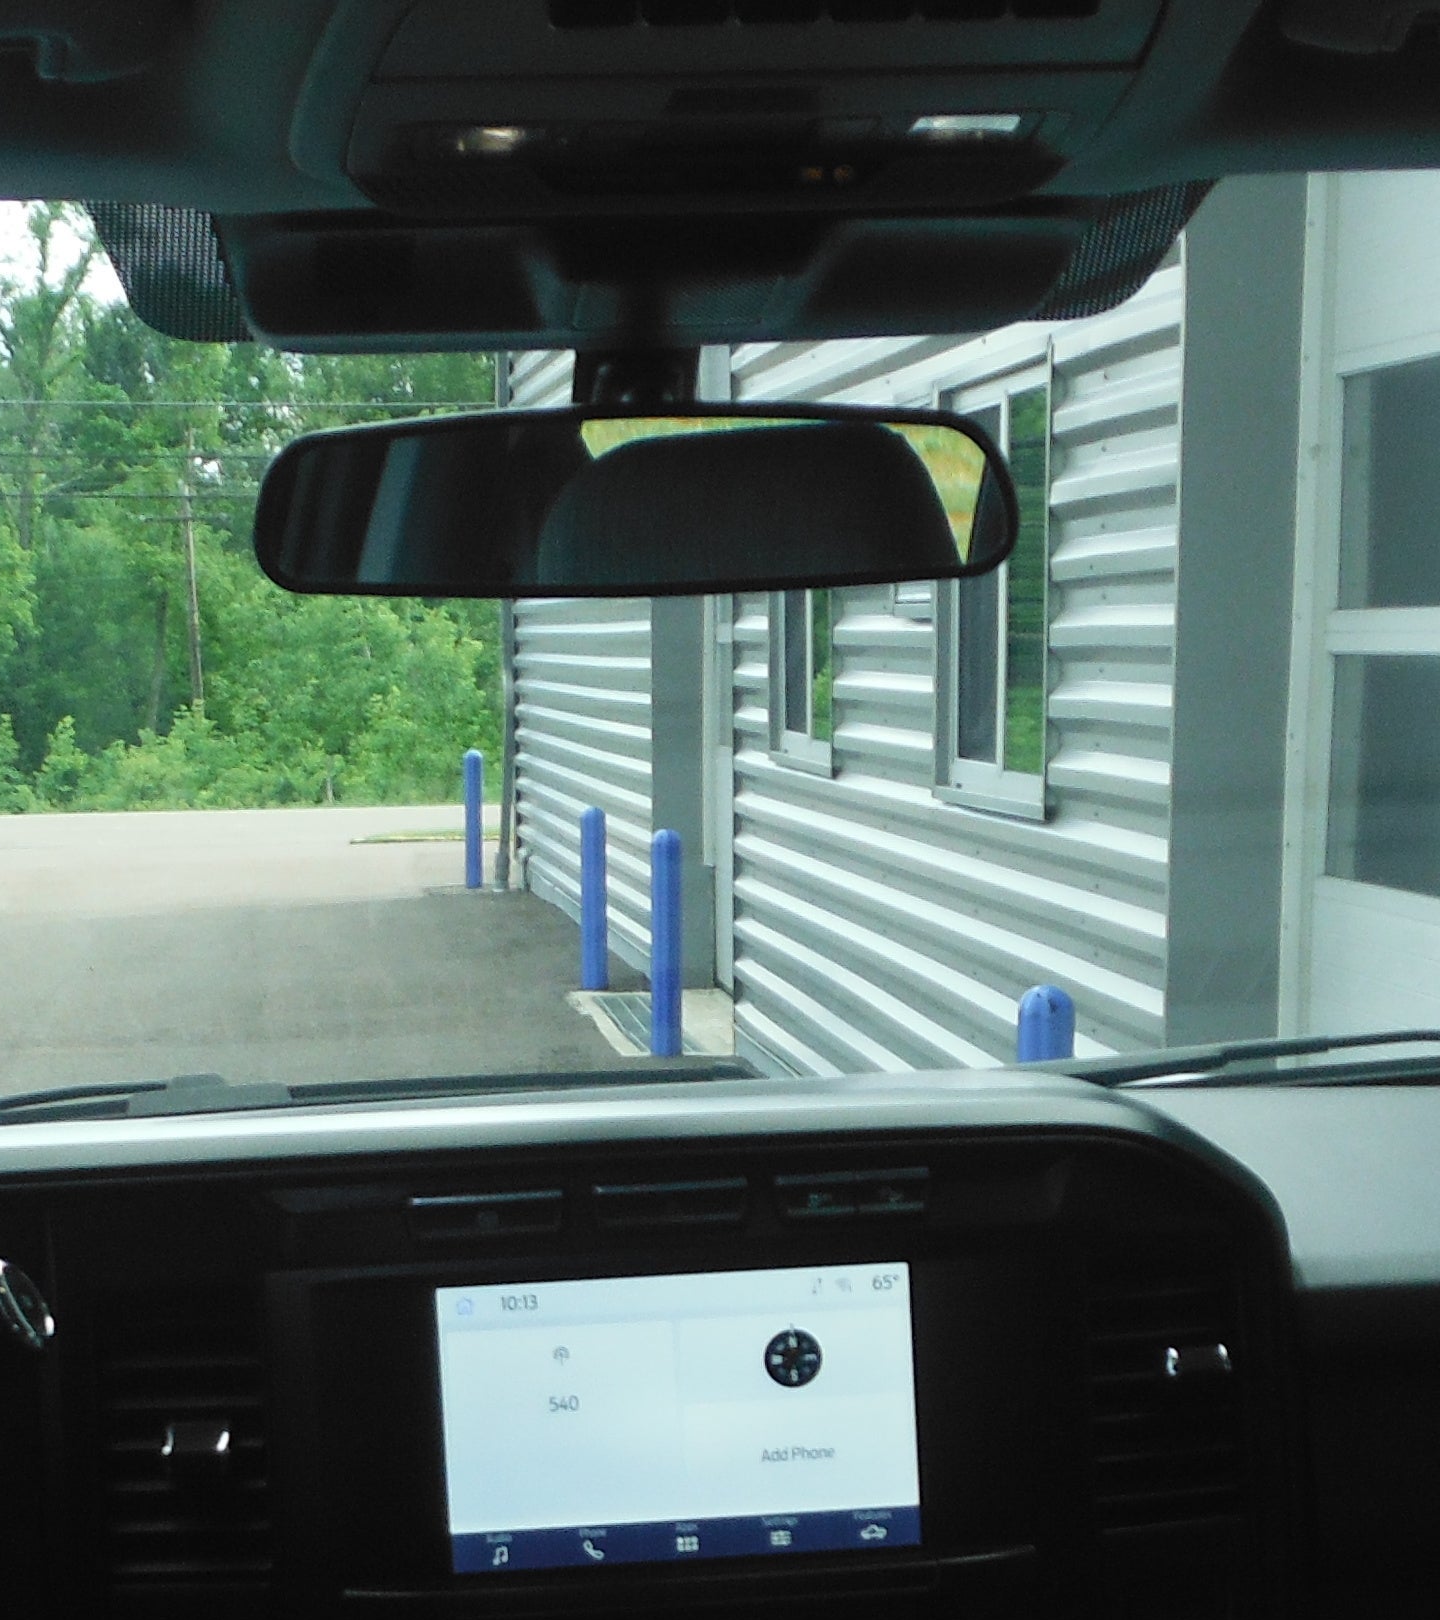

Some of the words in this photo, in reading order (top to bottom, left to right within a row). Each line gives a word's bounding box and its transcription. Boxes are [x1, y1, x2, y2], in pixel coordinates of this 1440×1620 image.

[500, 1294, 539, 1311] 10:13
[548, 1395, 580, 1413] 540
[761, 1448, 789, 1463] Add
[791, 1446, 836, 1461] Phone
